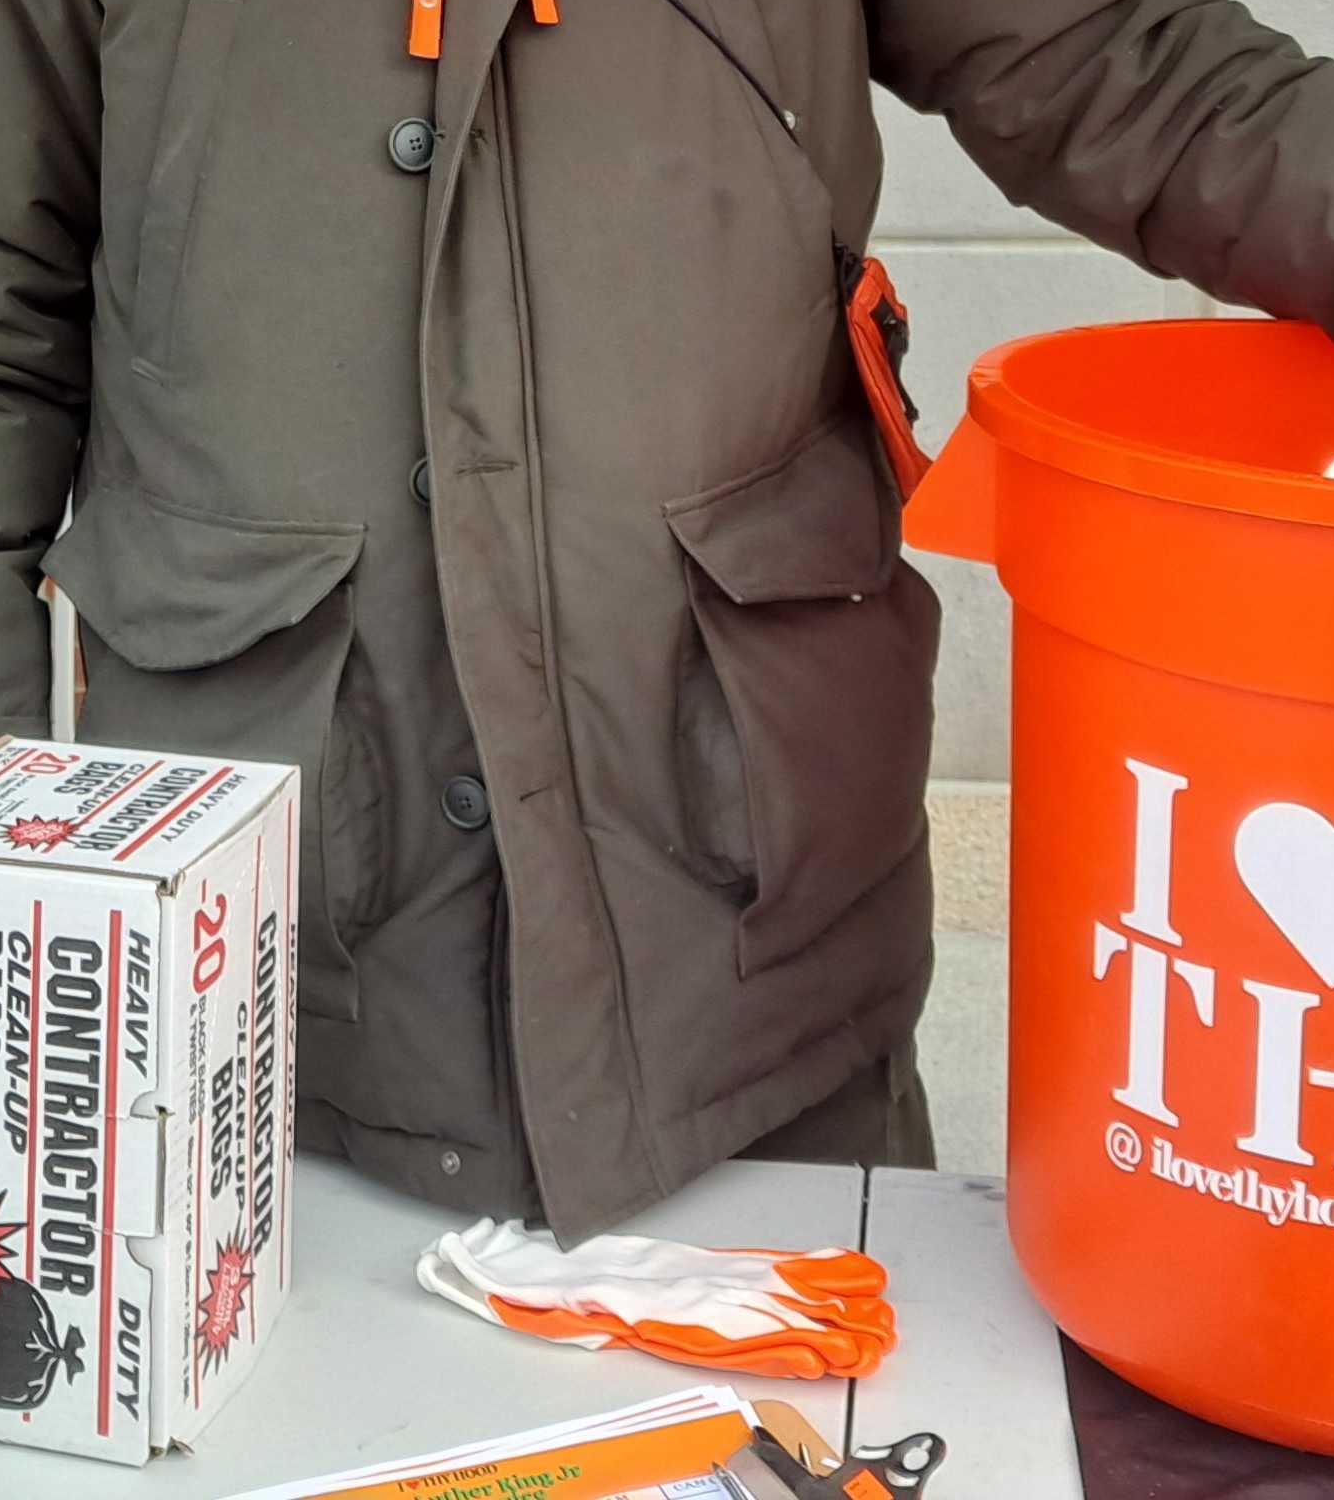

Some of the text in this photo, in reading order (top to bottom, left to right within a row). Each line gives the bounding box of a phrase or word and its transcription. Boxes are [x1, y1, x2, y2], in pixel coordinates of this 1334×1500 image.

[20, 752, 80, 776] 20
[53, 760, 126, 796] BAGS
[72, 766, 208, 852] CONTRACTOR
[166, 774, 247, 843] HEAVY DUTY
[1120, 756, 1189, 948] I
[193, 893, 227, 994] 20
[3, 930, 32, 1154] CLEAN-UP
[235, 1001, 248, 1211] CLEAN-UP
[253, 910, 277, 1259] CONTRACTOR
[40, 936, 103, 1297] CONTRACTOR
[117, 928, 151, 1422] HEAVY DUTY
[211, 1056, 234, 1200] BAGS
[496, 1467, 555, 1495] King
